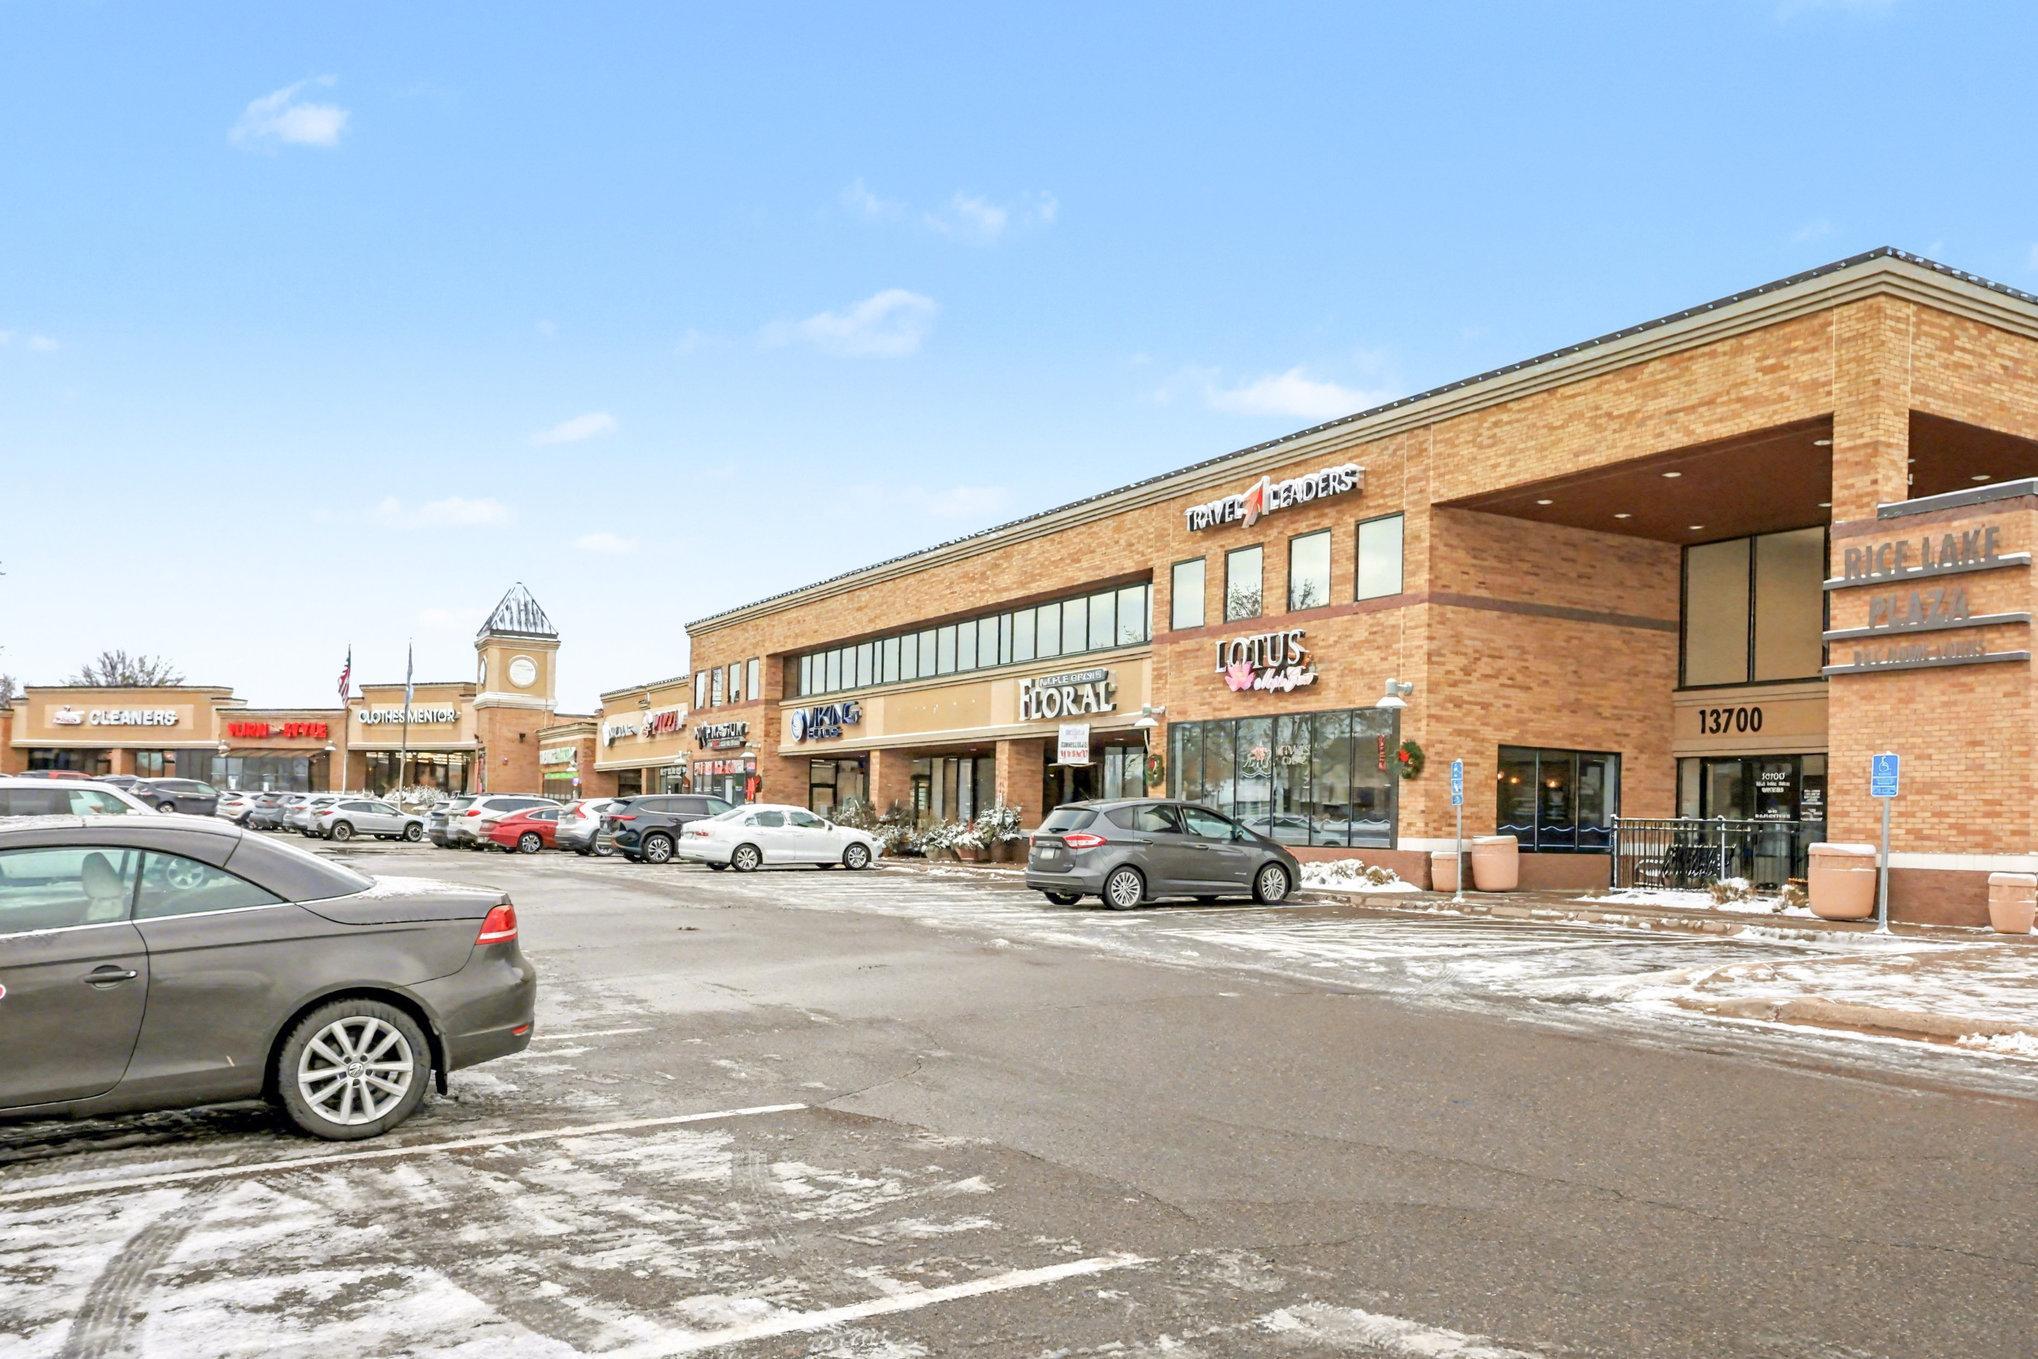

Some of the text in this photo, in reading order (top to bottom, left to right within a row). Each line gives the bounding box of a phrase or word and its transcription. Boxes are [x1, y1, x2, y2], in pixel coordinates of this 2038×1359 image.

[1185, 464, 1360, 532] TRAVEL LEADERS
[1844, 527, 1999, 581] RICE LAKE
[1868, 587, 1969, 629] PLAZA
[1215, 629, 1310, 673] LOTUS
[88, 710, 178, 726] CLEANERS
[358, 708, 457, 723] CLOTHES MENTOR
[804, 702, 863, 728] VIKING
[1018, 678, 1116, 721] FLORAL
[1699, 707, 1763, 734] 13700
